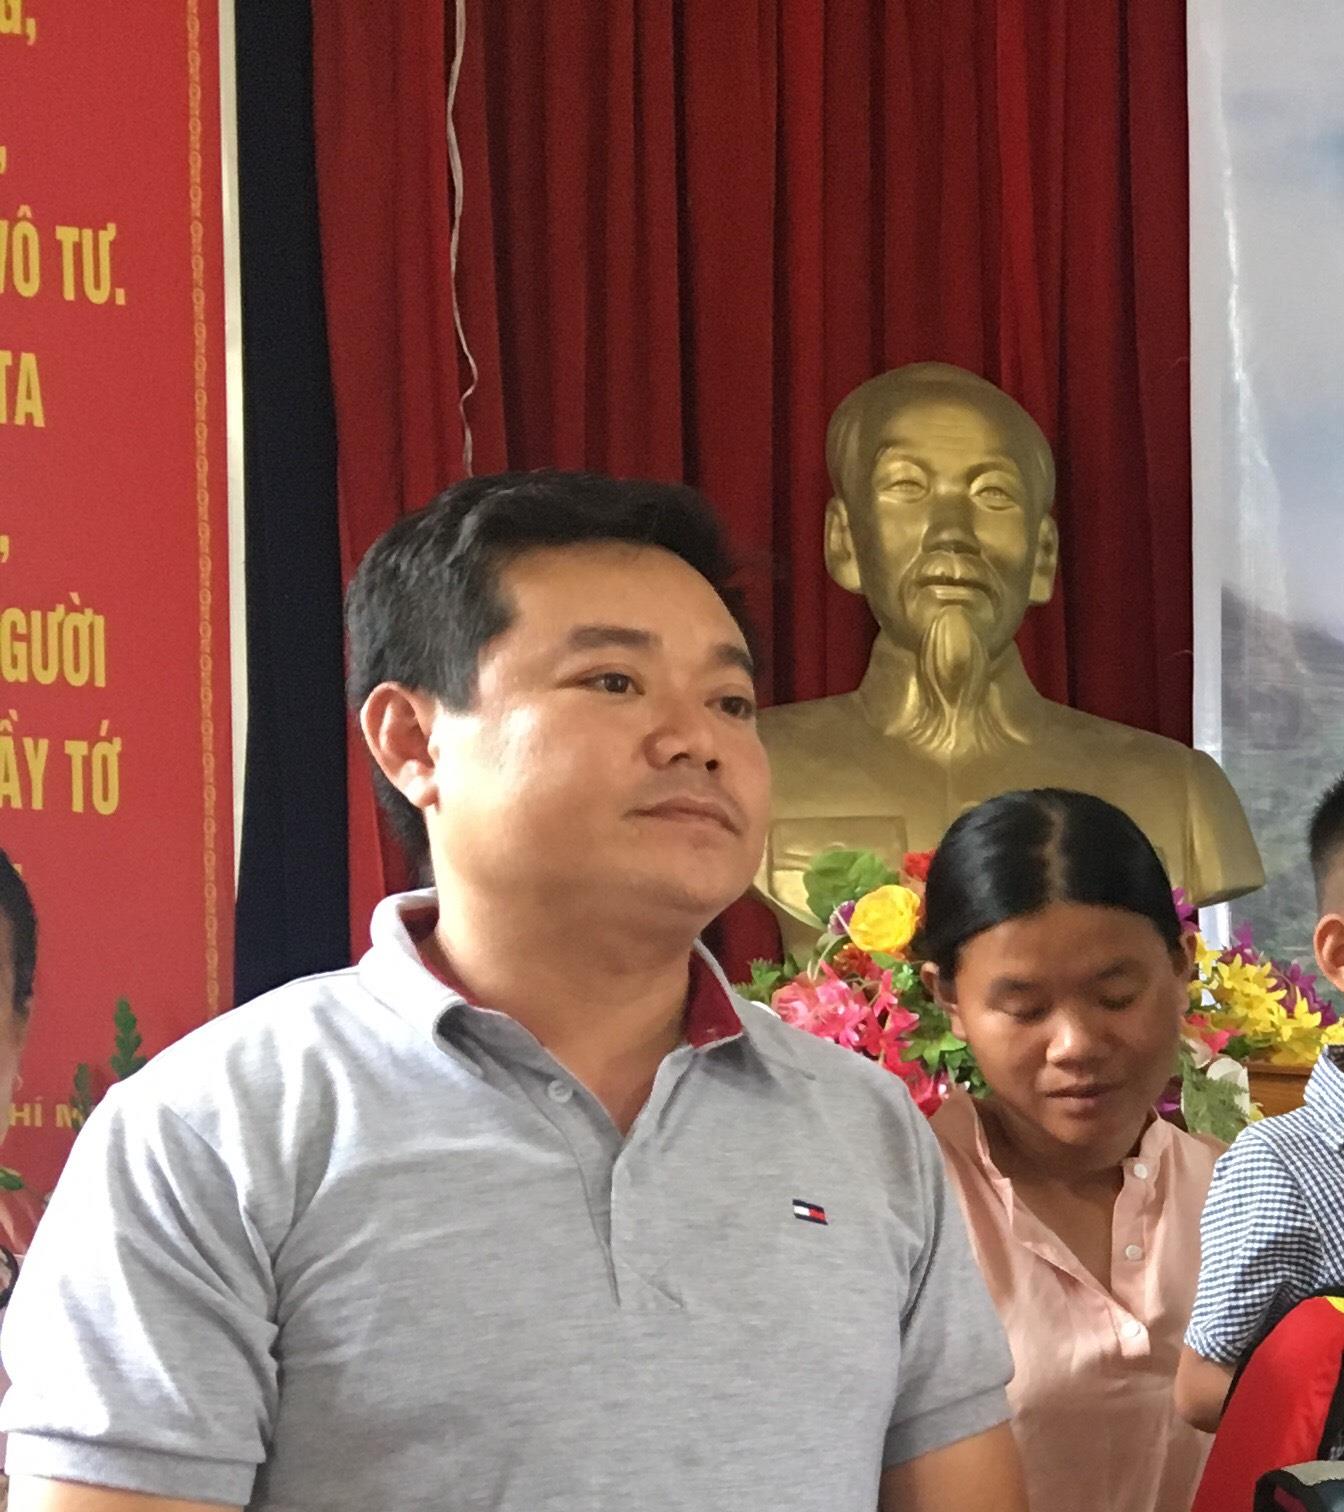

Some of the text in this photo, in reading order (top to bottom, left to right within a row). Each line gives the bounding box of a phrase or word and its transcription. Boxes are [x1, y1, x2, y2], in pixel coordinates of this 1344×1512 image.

[0, 205, 125, 305] Ô TƯ.
[64, 720, 122, 816] TỚ
